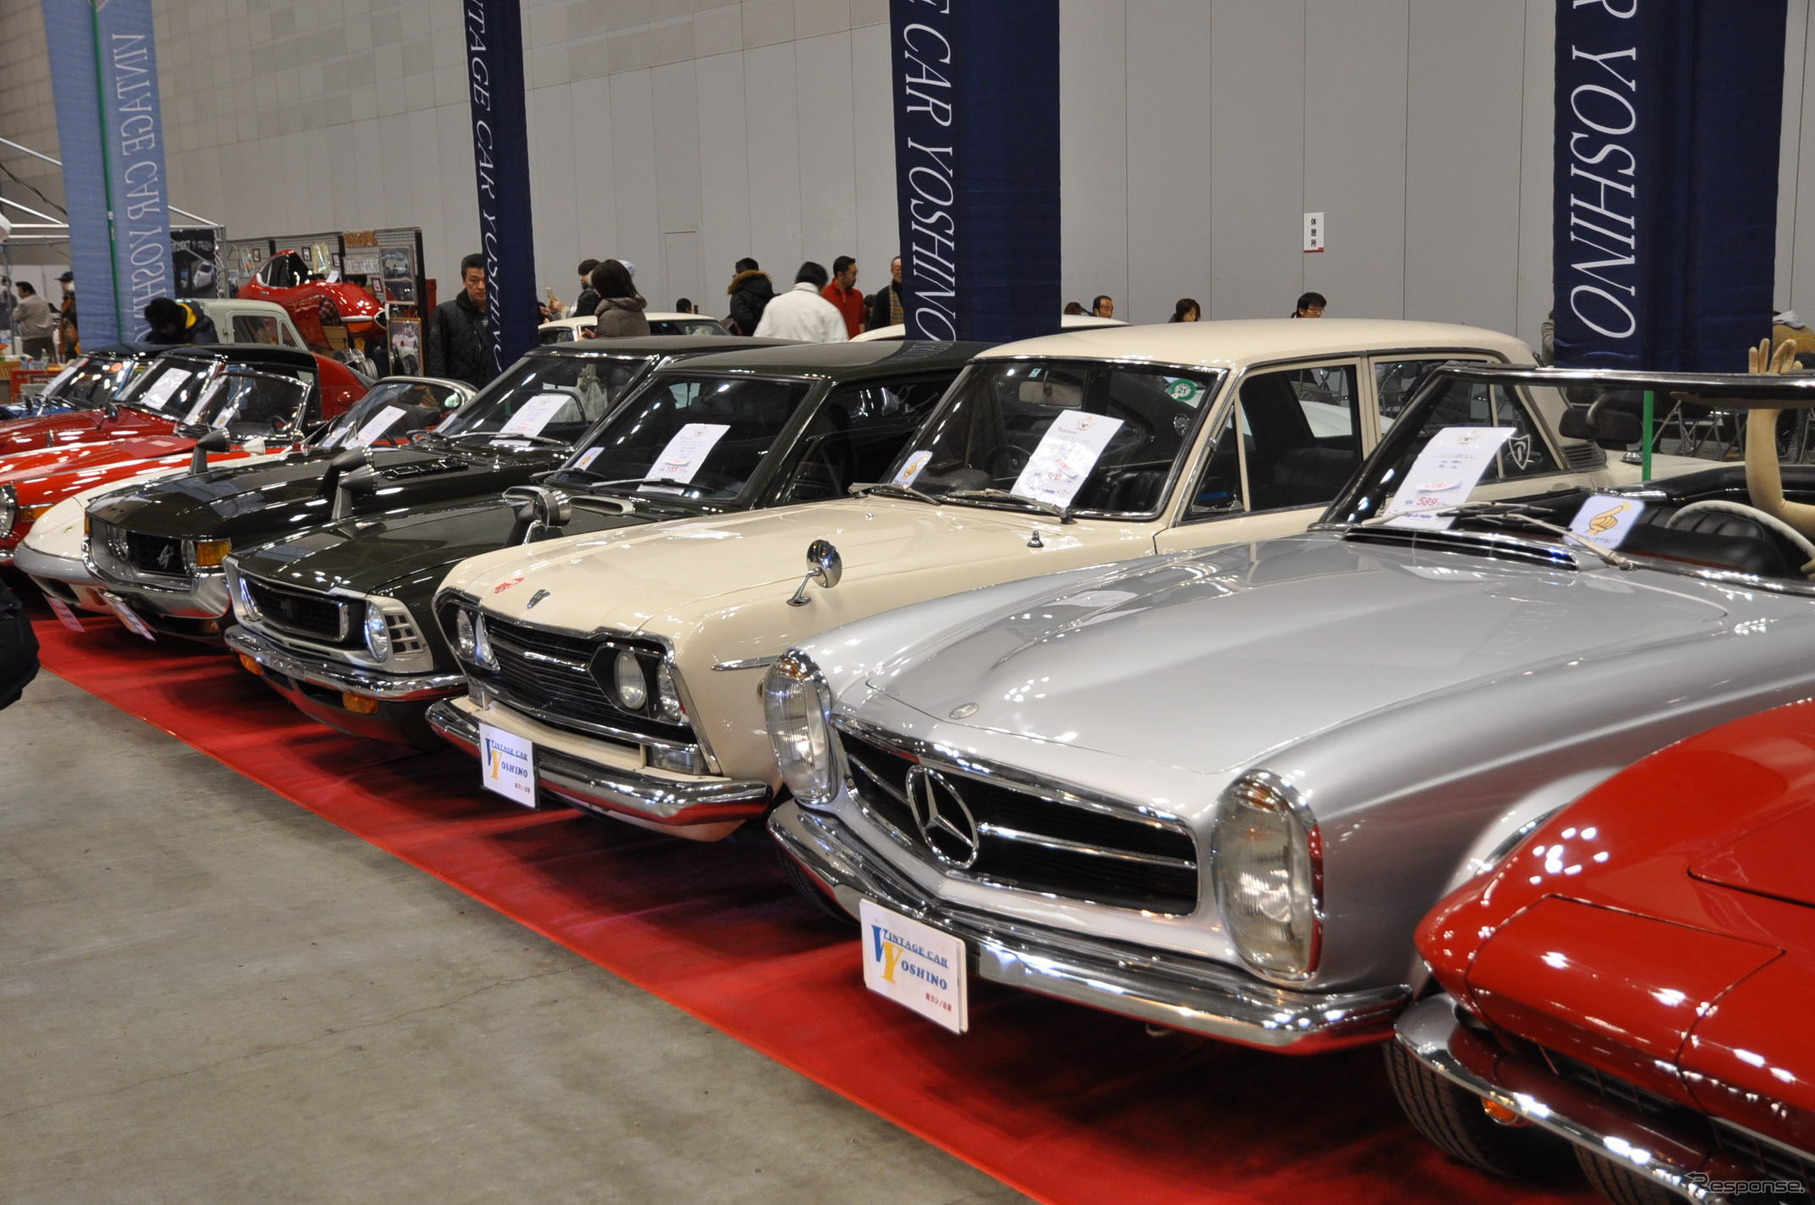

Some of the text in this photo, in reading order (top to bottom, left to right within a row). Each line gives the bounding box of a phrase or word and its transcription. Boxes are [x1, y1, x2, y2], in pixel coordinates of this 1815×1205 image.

[467, 0, 491, 111] TAGE
[903, 23, 952, 127] CAR
[908, 137, 956, 341] YOSHINO
[1570, 45, 1637, 338] YOSHINO
[490, 749, 528, 780] YOSHINO
[871, 924, 949, 969] VINTAGE CAR
[880, 940, 948, 990] YOSHINO
